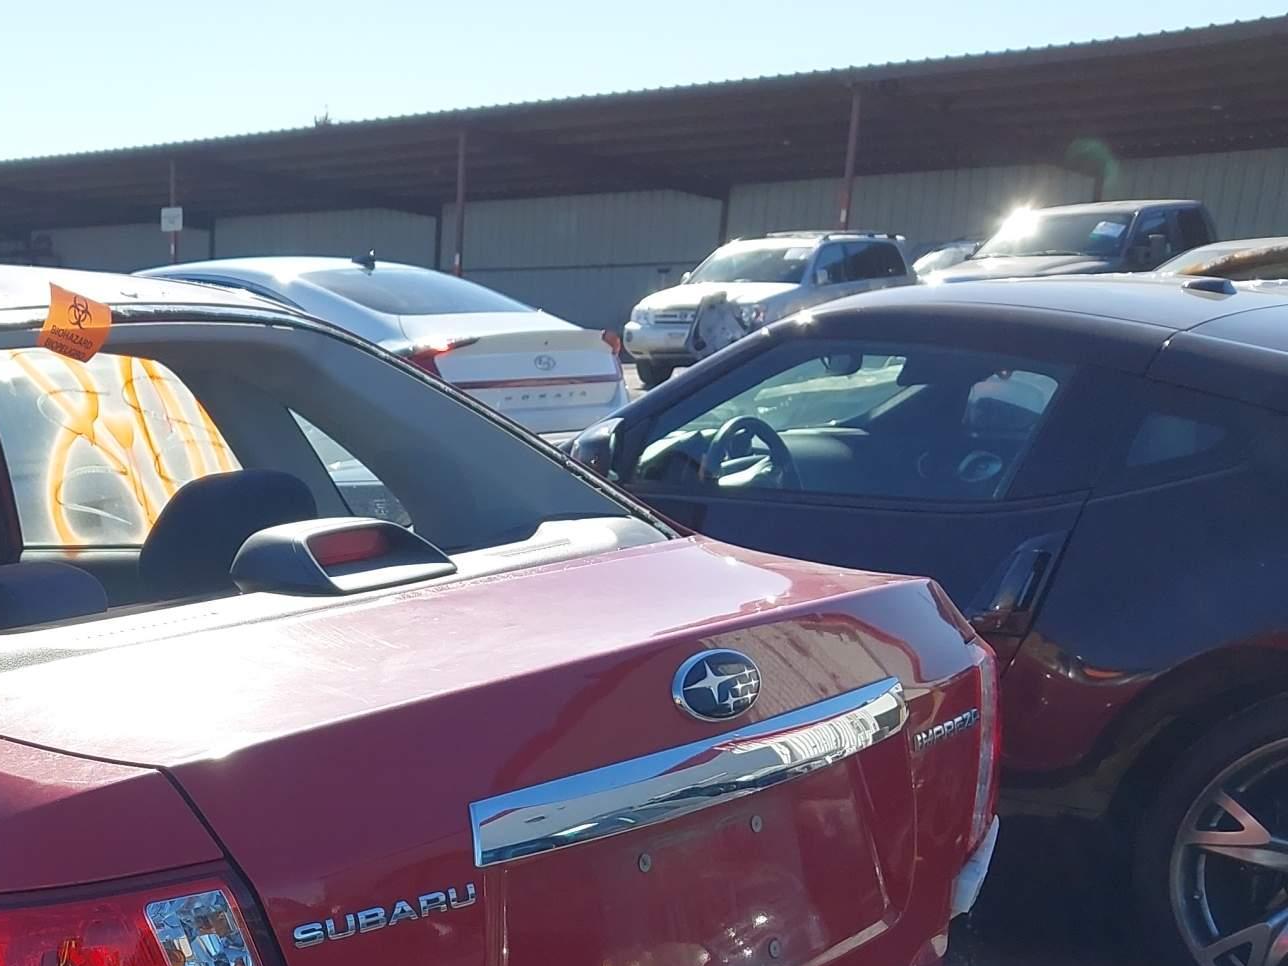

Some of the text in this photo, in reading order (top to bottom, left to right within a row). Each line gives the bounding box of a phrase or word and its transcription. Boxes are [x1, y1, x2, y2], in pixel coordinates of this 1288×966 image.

[50, 324, 94, 350] BIOHAZARD
[913, 706, 981, 753] IMPREZA
[292, 882, 477, 949] SUBARU
